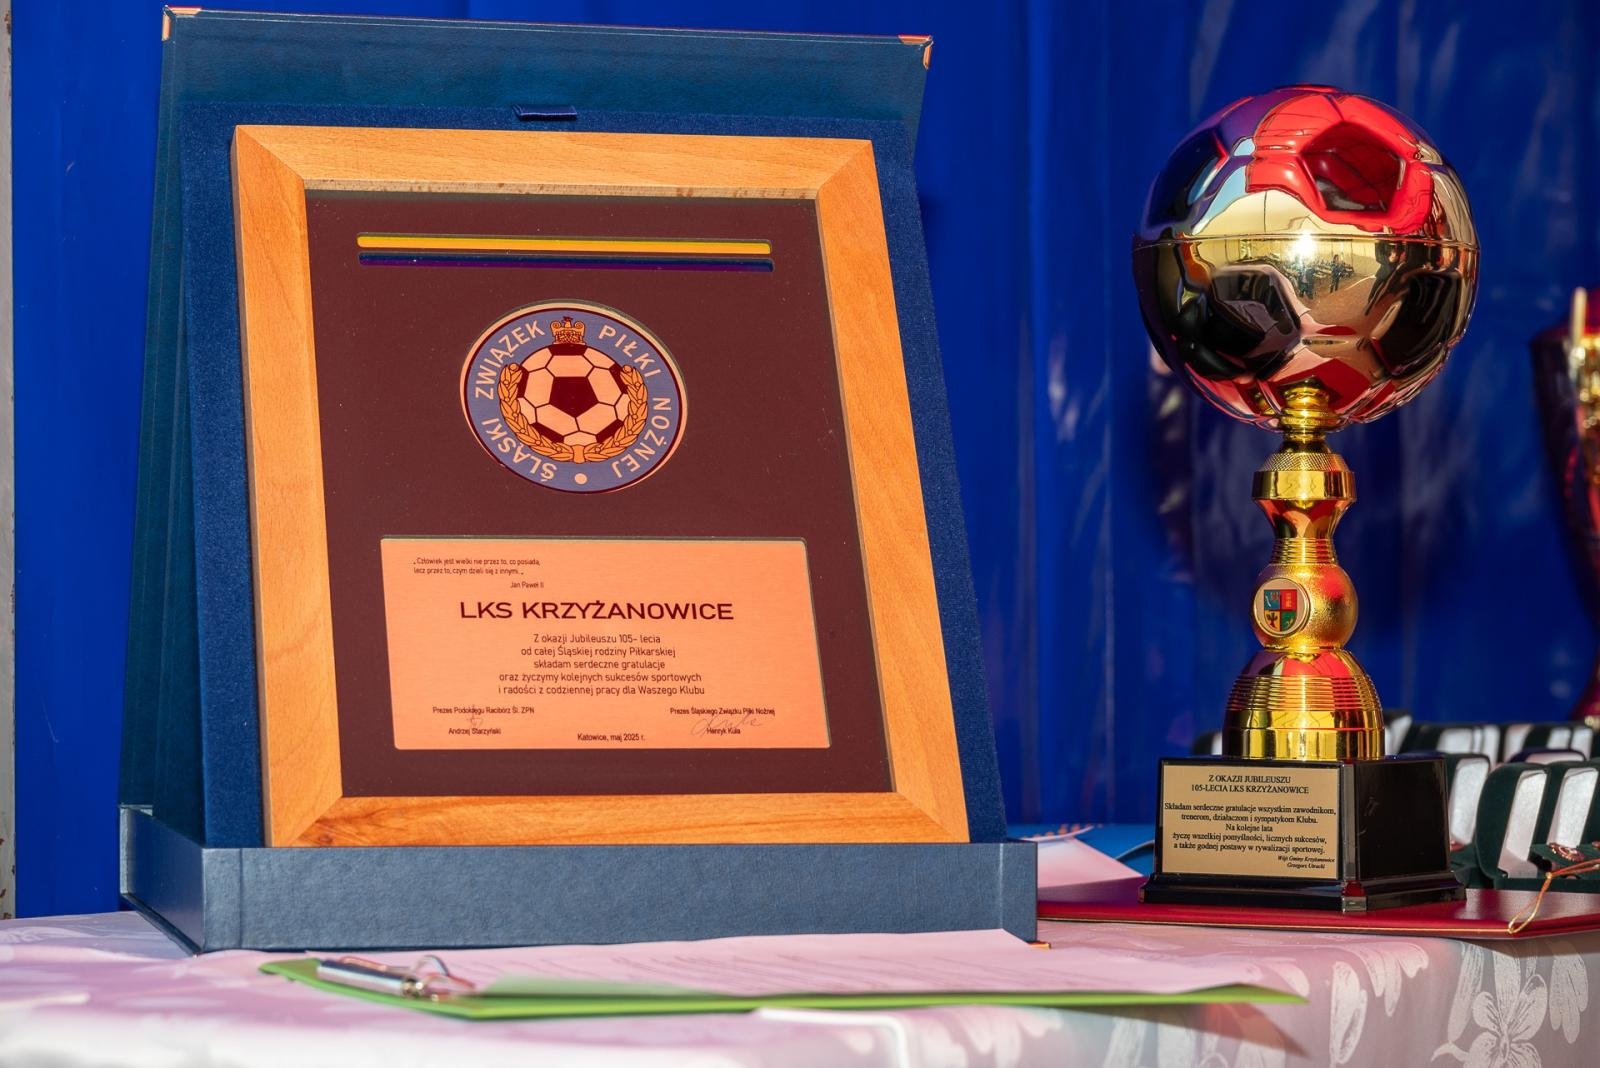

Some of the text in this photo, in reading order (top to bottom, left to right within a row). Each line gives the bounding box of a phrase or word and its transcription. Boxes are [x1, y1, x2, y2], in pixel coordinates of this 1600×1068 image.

[475, 320, 672, 482] ŚLĄSKI ZWIĄZEK PIŁKI NOŻNEJ
[460, 600, 734, 620] LKS KRZYŻANOWICE
[534, 634, 539, 643] Z
[542, 634, 567, 644] okazji
[570, 634, 617, 643] Jubileuszu
[640, 634, 660, 644] lecia
[521, 645, 675, 658] od całej Śląskiej rodziny Piłkarskiej
[534, 659, 665, 670] składam serdeczne gratulacje
[522, 673, 558, 683] życzymy
[561, 672, 603, 683] kolejnych
[605, 672, 648, 682] sukcesów
[651, 673, 701, 684] sportowych
[504, 685, 536, 694] radości
[546, 686, 593, 696] codziennej
[596, 687, 620, 697] pracy
[622, 686, 636, 695] dla
[638, 686, 677, 696] Waszego
[680, 686, 705, 695] Klubu
[577, 733, 608, 742] Katowice,
[610, 733, 622, 743] maj
[624, 733, 640, 741] 2025
[1246, 785, 1309, 794] KRZYŻANOWICE
[1225, 805, 1256, 813] gratulacje
[1258, 805, 1291, 814] wszystkim
[1236, 824, 1260, 833] kolejne
[1266, 835, 1293, 843] licznych
[1197, 843, 1218, 851] godnej
[1255, 844, 1290, 853] rywalizacji
